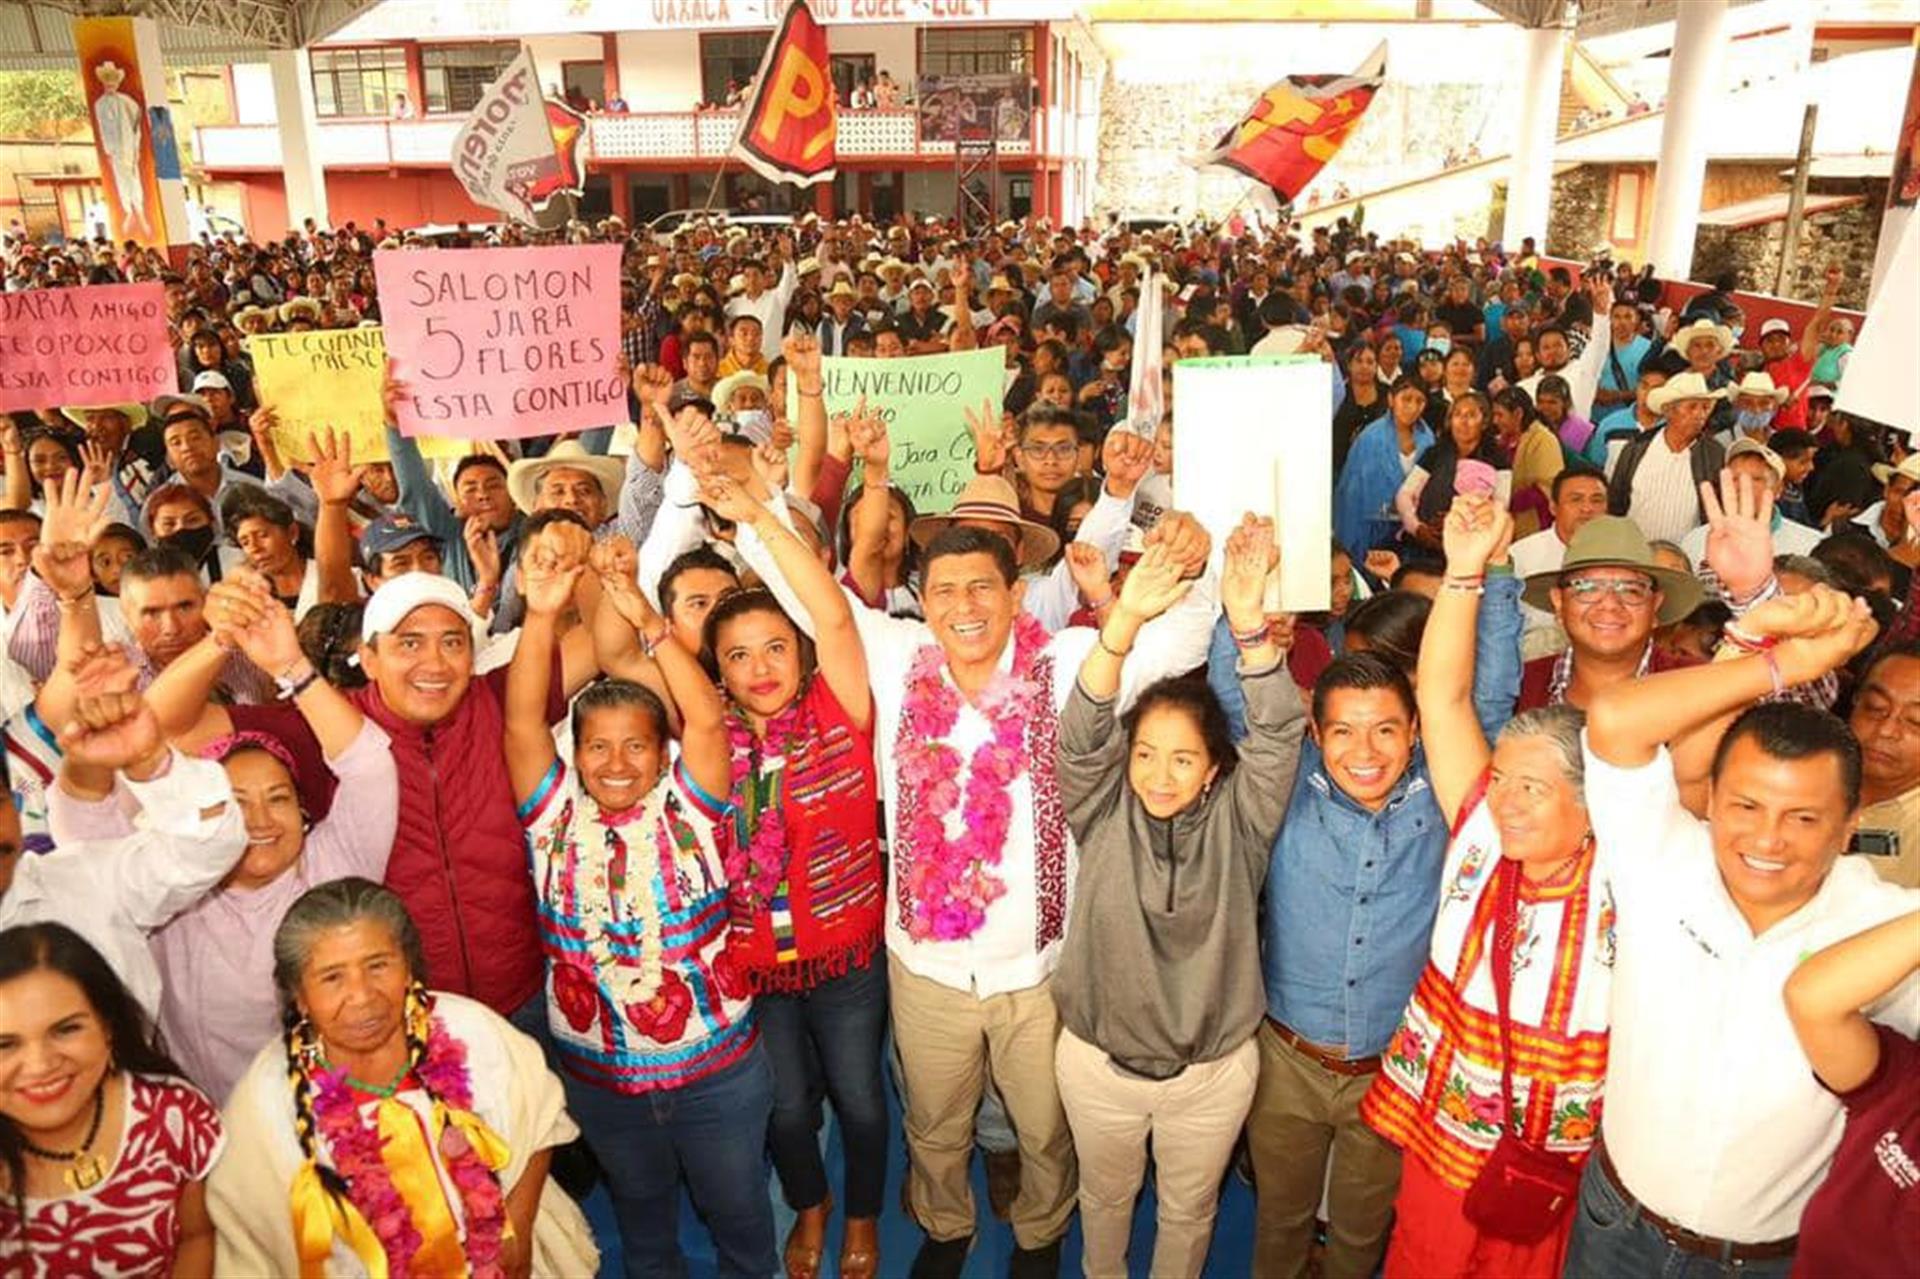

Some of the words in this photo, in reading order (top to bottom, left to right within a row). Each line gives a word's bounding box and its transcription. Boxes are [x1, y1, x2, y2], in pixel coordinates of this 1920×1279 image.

[410, 266, 592, 307] SALOMON
[1, 292, 79, 321] JARA
[486, 304, 573, 339] JARA
[420, 316, 464, 380] 5
[478, 337, 605, 375] FLORES
[68, 366, 168, 387] CONTIGO
[822, 369, 963, 396] IENVENIDO
[412, 393, 493, 420] ESTA
[513, 376, 624, 414] CONTIGO
[894, 441, 938, 471] Jara
